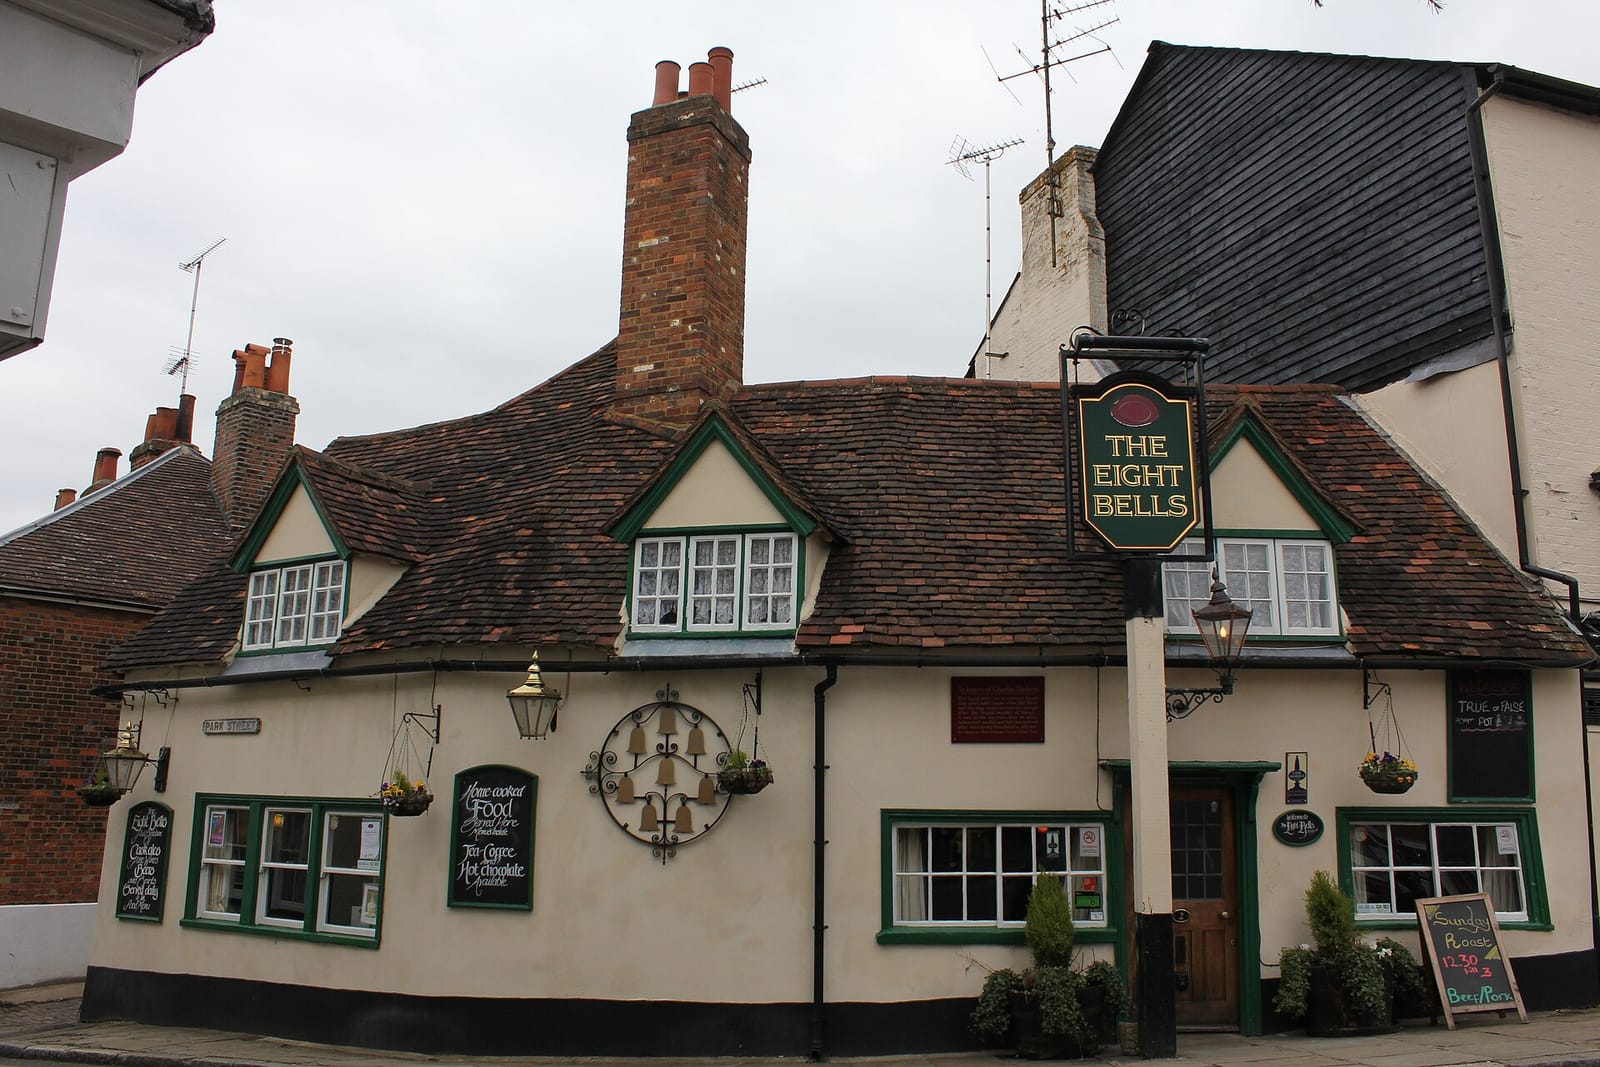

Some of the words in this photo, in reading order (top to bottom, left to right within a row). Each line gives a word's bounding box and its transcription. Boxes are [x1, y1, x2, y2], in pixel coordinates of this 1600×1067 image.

[1105, 434, 1168, 457] THE
[1092, 464, 1184, 487] EIGHT
[1092, 494, 1188, 518] BELLS
[1458, 700, 1491, 713] TRUE
[1500, 700, 1526, 713] FALSE
[205, 721, 224, 731] PARK
[227, 720, 256, 731] STREET
[472, 797, 513, 819] Food
[457, 861, 480, 884] Hot
[1433, 905, 1491, 934] Sunday
[1445, 932, 1492, 949] Roast
[1442, 954, 1479, 969] 12.30
[1480, 967, 1493, 978] 3
